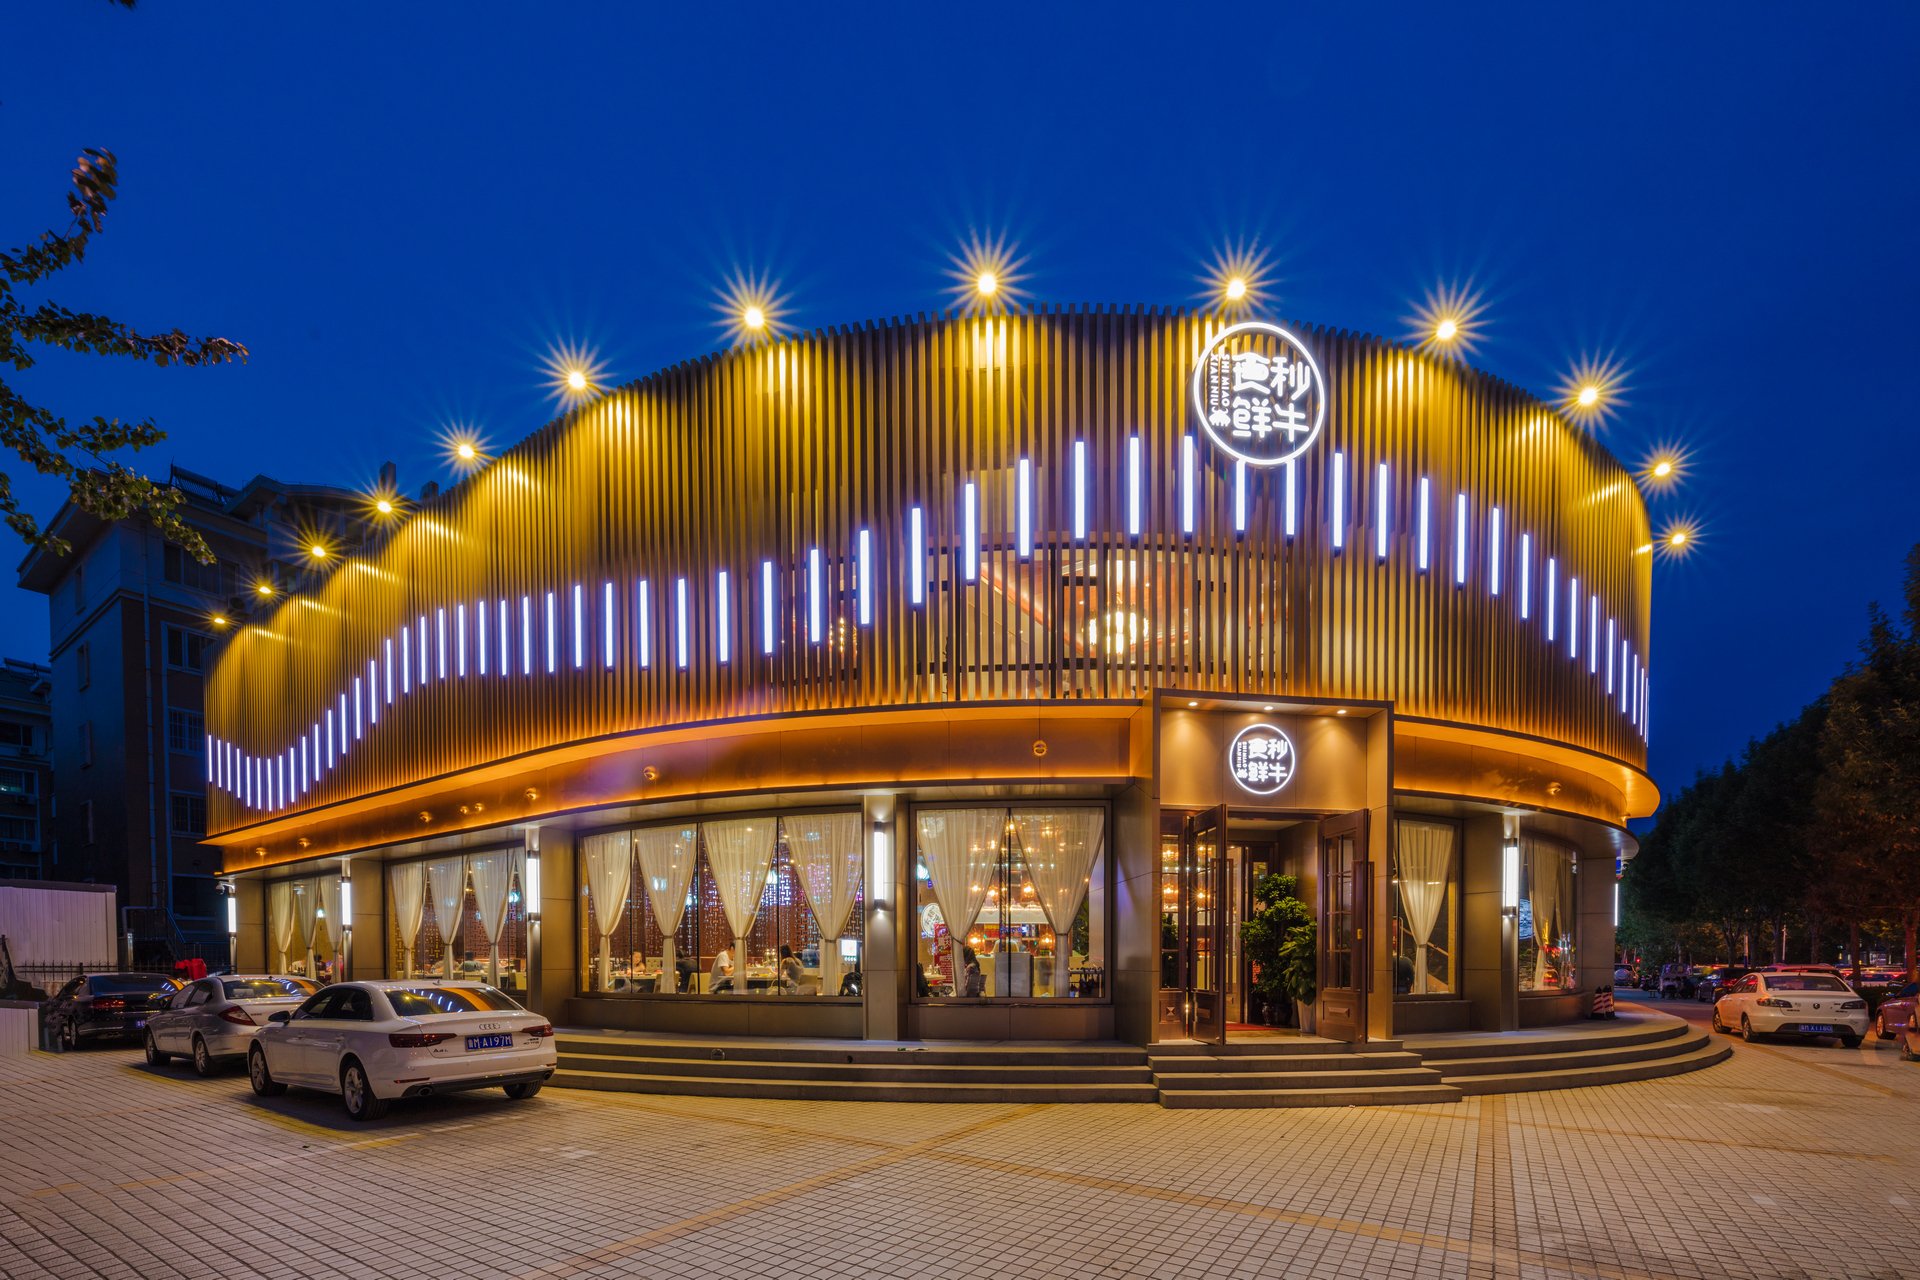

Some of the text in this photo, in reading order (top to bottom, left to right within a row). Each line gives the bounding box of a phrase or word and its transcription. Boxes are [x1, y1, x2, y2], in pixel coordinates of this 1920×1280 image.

[1210, 354, 1219, 406] XIAN NIU
[1221, 354, 1230, 407] SHI MIAO
[1232, 396, 1310, 443] 鲜牛
